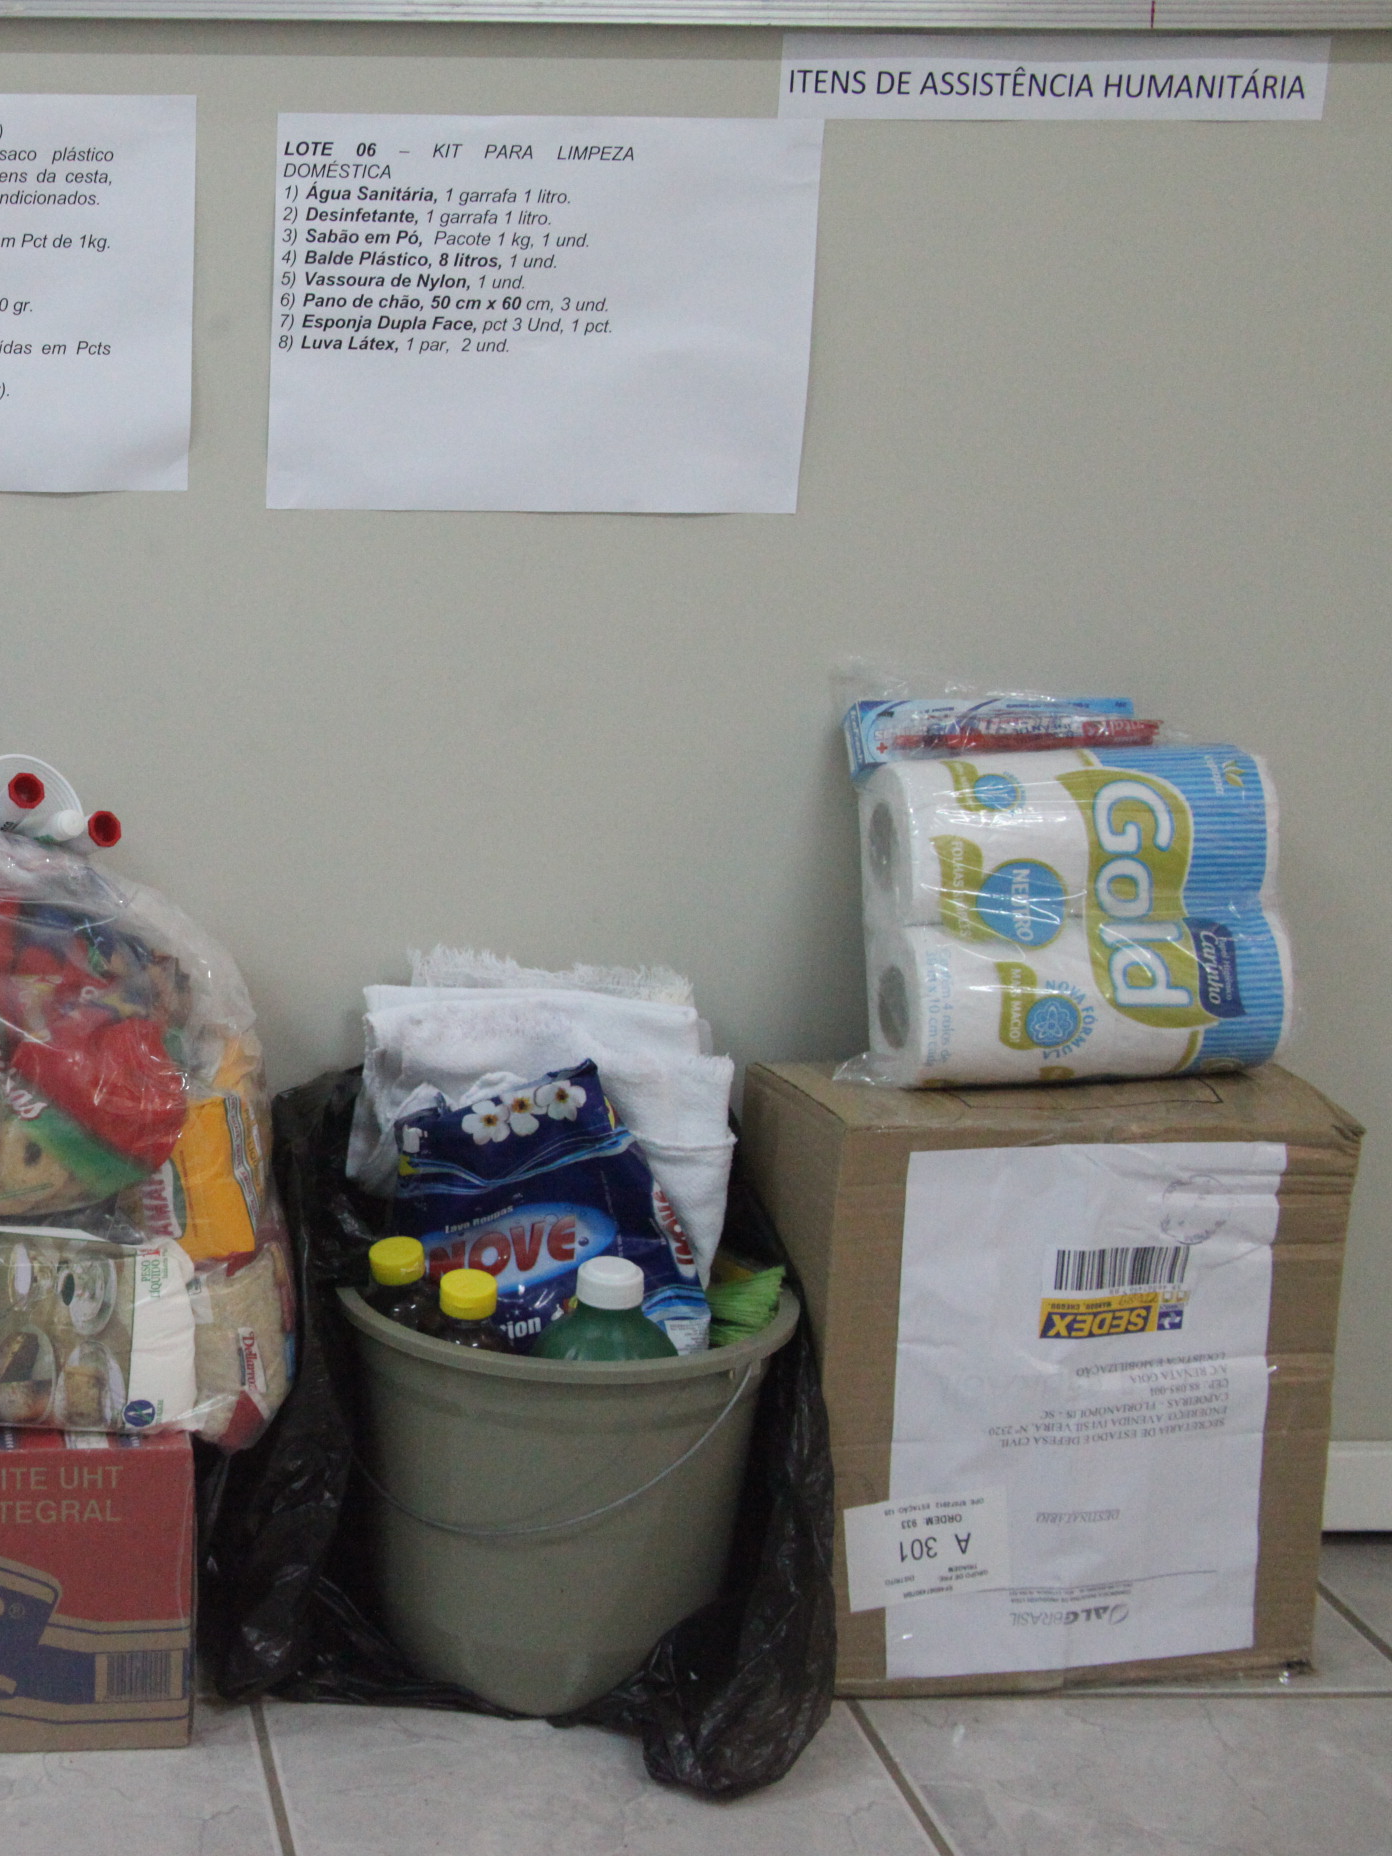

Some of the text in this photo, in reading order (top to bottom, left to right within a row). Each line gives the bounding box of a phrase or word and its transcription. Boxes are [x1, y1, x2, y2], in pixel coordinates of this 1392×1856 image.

[789, 65, 1306, 100] ITENS DE ASSISTÊNCIA HUMANITÁRIA
[283, 140, 635, 162] LOTE 06 KIT PARA LIMPEZA
[282, 159, 392, 180] DOMÉSTICA
[284, 180, 572, 207] 1) Água Sanitária, 1 garrafa 1 litro.
[281, 227, 589, 251] 3) Sabão em Pó, Pacote 1 kg, 1 und.
[277, 334, 510, 355] 8) Luva Látex, 1 par, 2 und.
[1010, 868, 1035, 941] NEUTRO
[1092, 779, 1194, 1009] Gold
[1199, 930, 1224, 1005] Carinho
[428, 1213, 577, 1283] NOVE
[1046, 1307, 1148, 1338] SEDEX
[58, 1464, 123, 1492] UHT
[900, 1518, 918, 1530] 933
[899, 1531, 972, 1563] A 301
